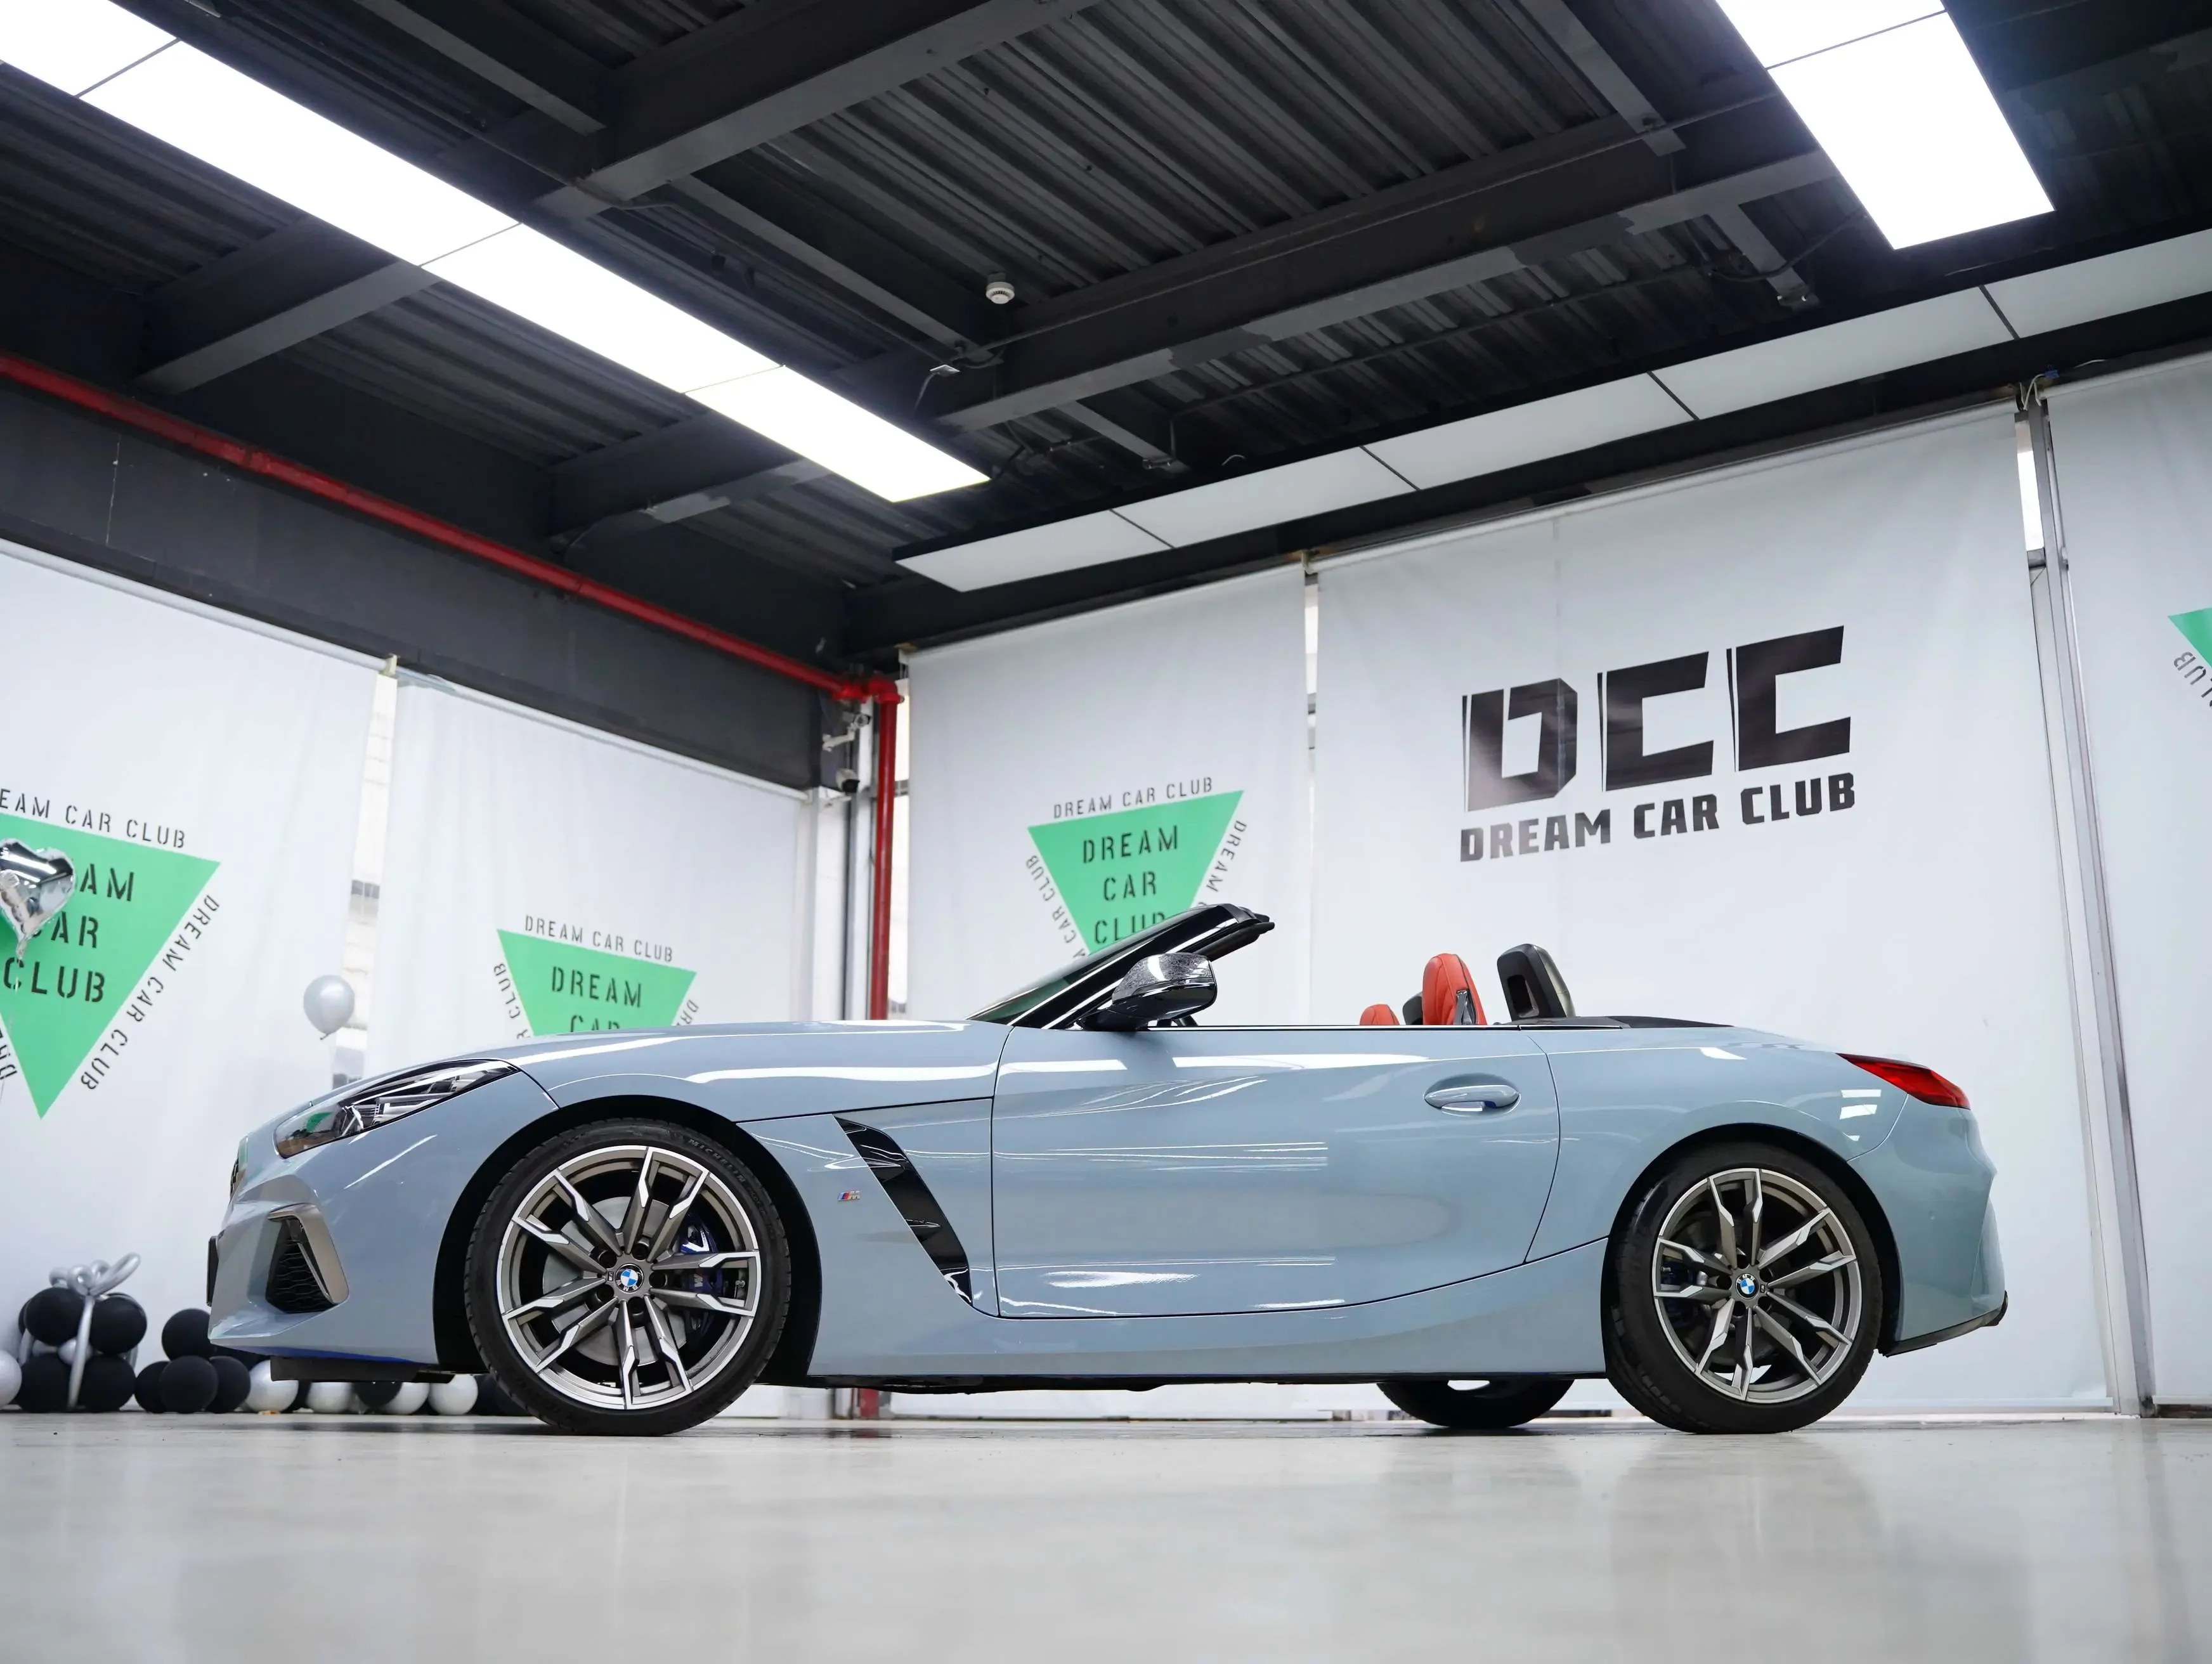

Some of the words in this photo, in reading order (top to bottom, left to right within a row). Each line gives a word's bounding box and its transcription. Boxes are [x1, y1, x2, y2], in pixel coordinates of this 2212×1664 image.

[1462, 625, 1851, 812] DCC
[0, 788, 50, 819] EAM
[65, 804, 112, 833] CAR
[126, 819, 185, 849] CLUB
[1053, 795, 1112, 819] DREAM
[1122, 787, 1156, 807] CAR
[1166, 777, 1213, 799] CLUB
[1461, 809, 1611, 862] DREAM
[1633, 793, 1720, 839] CAR
[1740, 772, 1856, 825] CLUB
[1083, 824, 1178, 864] DREAM
[1206, 819, 1247, 893] DREAM
[1025, 854, 1056, 902] CLUB
[1103, 870, 1157, 902] CAR
[32, 911, 99, 949] AR
[161, 894, 221, 972] DREAM
[524, 914, 583, 944] DREAM
[592, 930, 625, 952] CAR
[633, 939, 673, 963] CLUB
[1051, 905, 1077, 944] CAR
[3, 956, 106, 1003] CLUB
[126, 975, 165, 1024] CAR
[493, 962, 521, 1019] CLUB
[551, 965, 642, 1008] DREAM
[80, 1028, 129, 1091] CLUB
